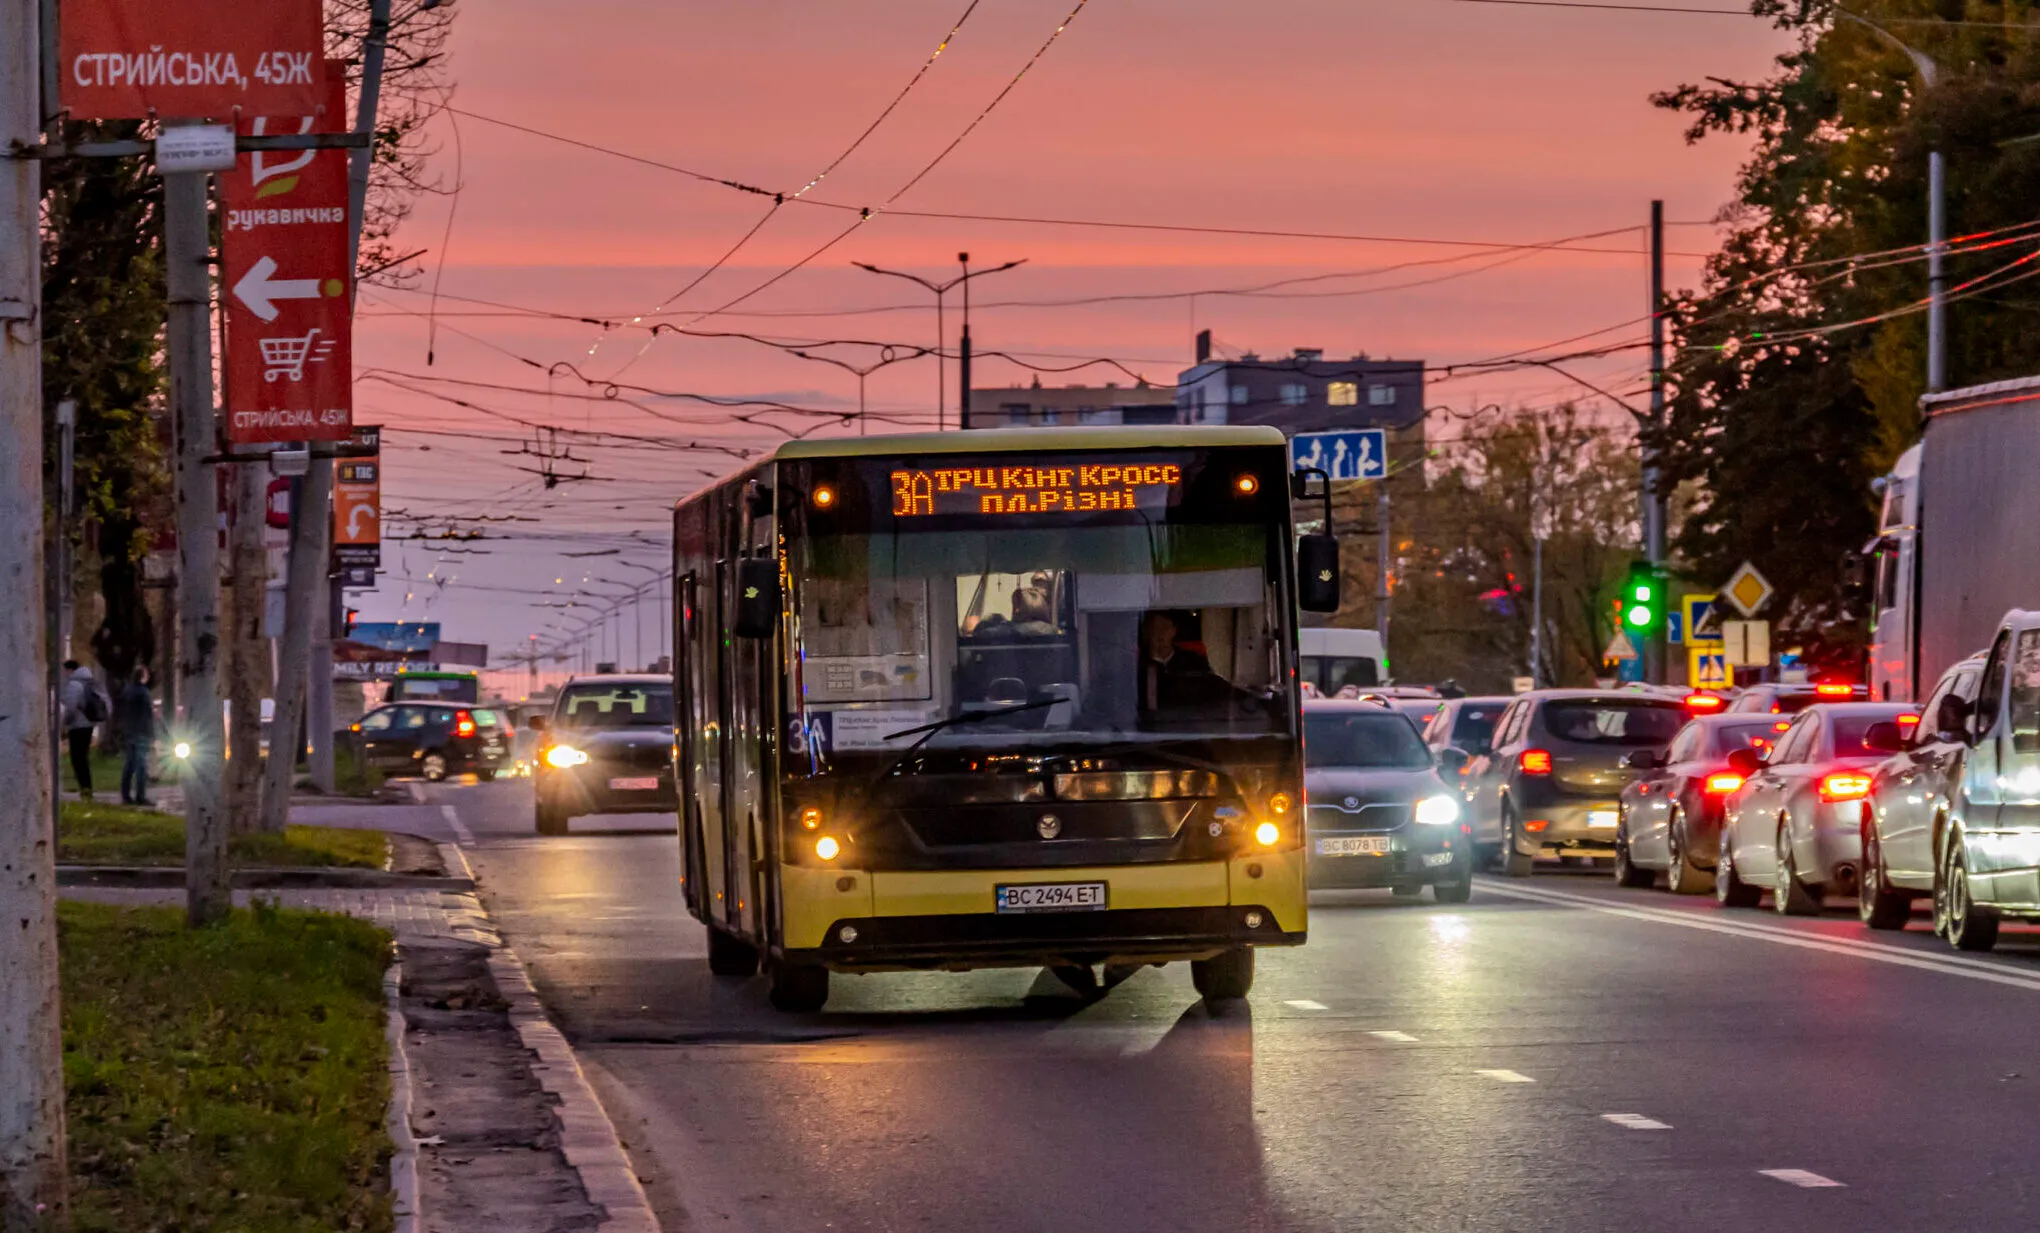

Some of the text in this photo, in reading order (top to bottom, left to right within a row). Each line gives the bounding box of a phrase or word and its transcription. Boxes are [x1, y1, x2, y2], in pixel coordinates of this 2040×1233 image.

[73, 45, 313, 91] СТРИЙСЬКА, 45Ж
[227, 206, 345, 231] рукавичка
[233, 406, 348, 429] СТРИЙСЬКА, 45Ж
[934, 469, 998, 491] ТРЦ
[1002, 467, 1075, 489] Кінг
[891, 470, 933, 516] 3А
[1341, 839, 1370, 851] 8078
[1008, 886, 1100, 905] BC 2494 ET
